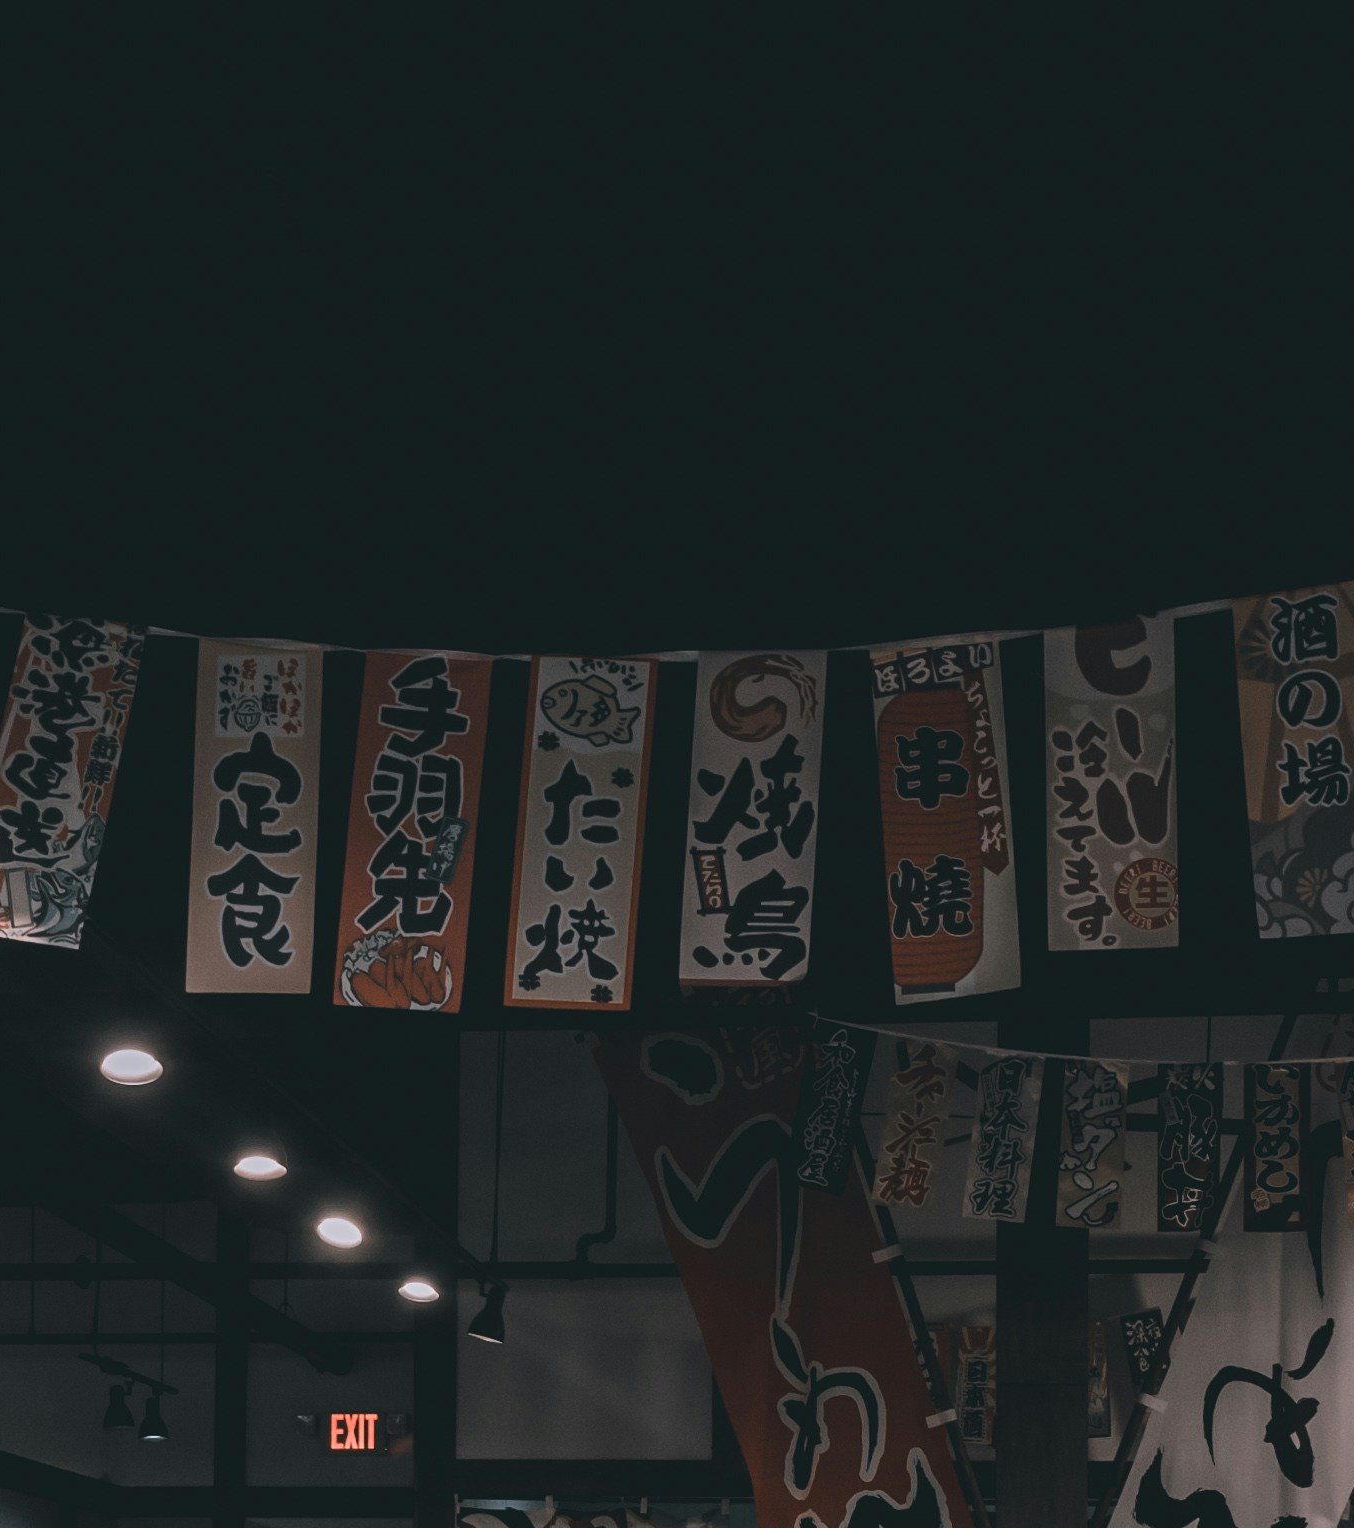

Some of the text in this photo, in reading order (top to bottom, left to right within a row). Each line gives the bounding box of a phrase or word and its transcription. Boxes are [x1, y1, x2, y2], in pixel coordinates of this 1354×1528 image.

[874, 643, 993, 694] ほろよい
[1269, 593, 1351, 806] 酒の場
[207, 732, 303, 968] 定食
[356, 657, 467, 935] 手羽先
[693, 735, 816, 981] 焼鳥
[966, 680, 1007, 854] ちょこっと一杯
[1051, 720, 1117, 946] 冷えてます。
[524, 758, 618, 980] たい焼
[1135, 875, 1169, 909] 生
[969, 1059, 1030, 1218] 日本料理
[1253, 1063, 1301, 1194] いかめし
[330, 1413, 377, 1450] EXIT
